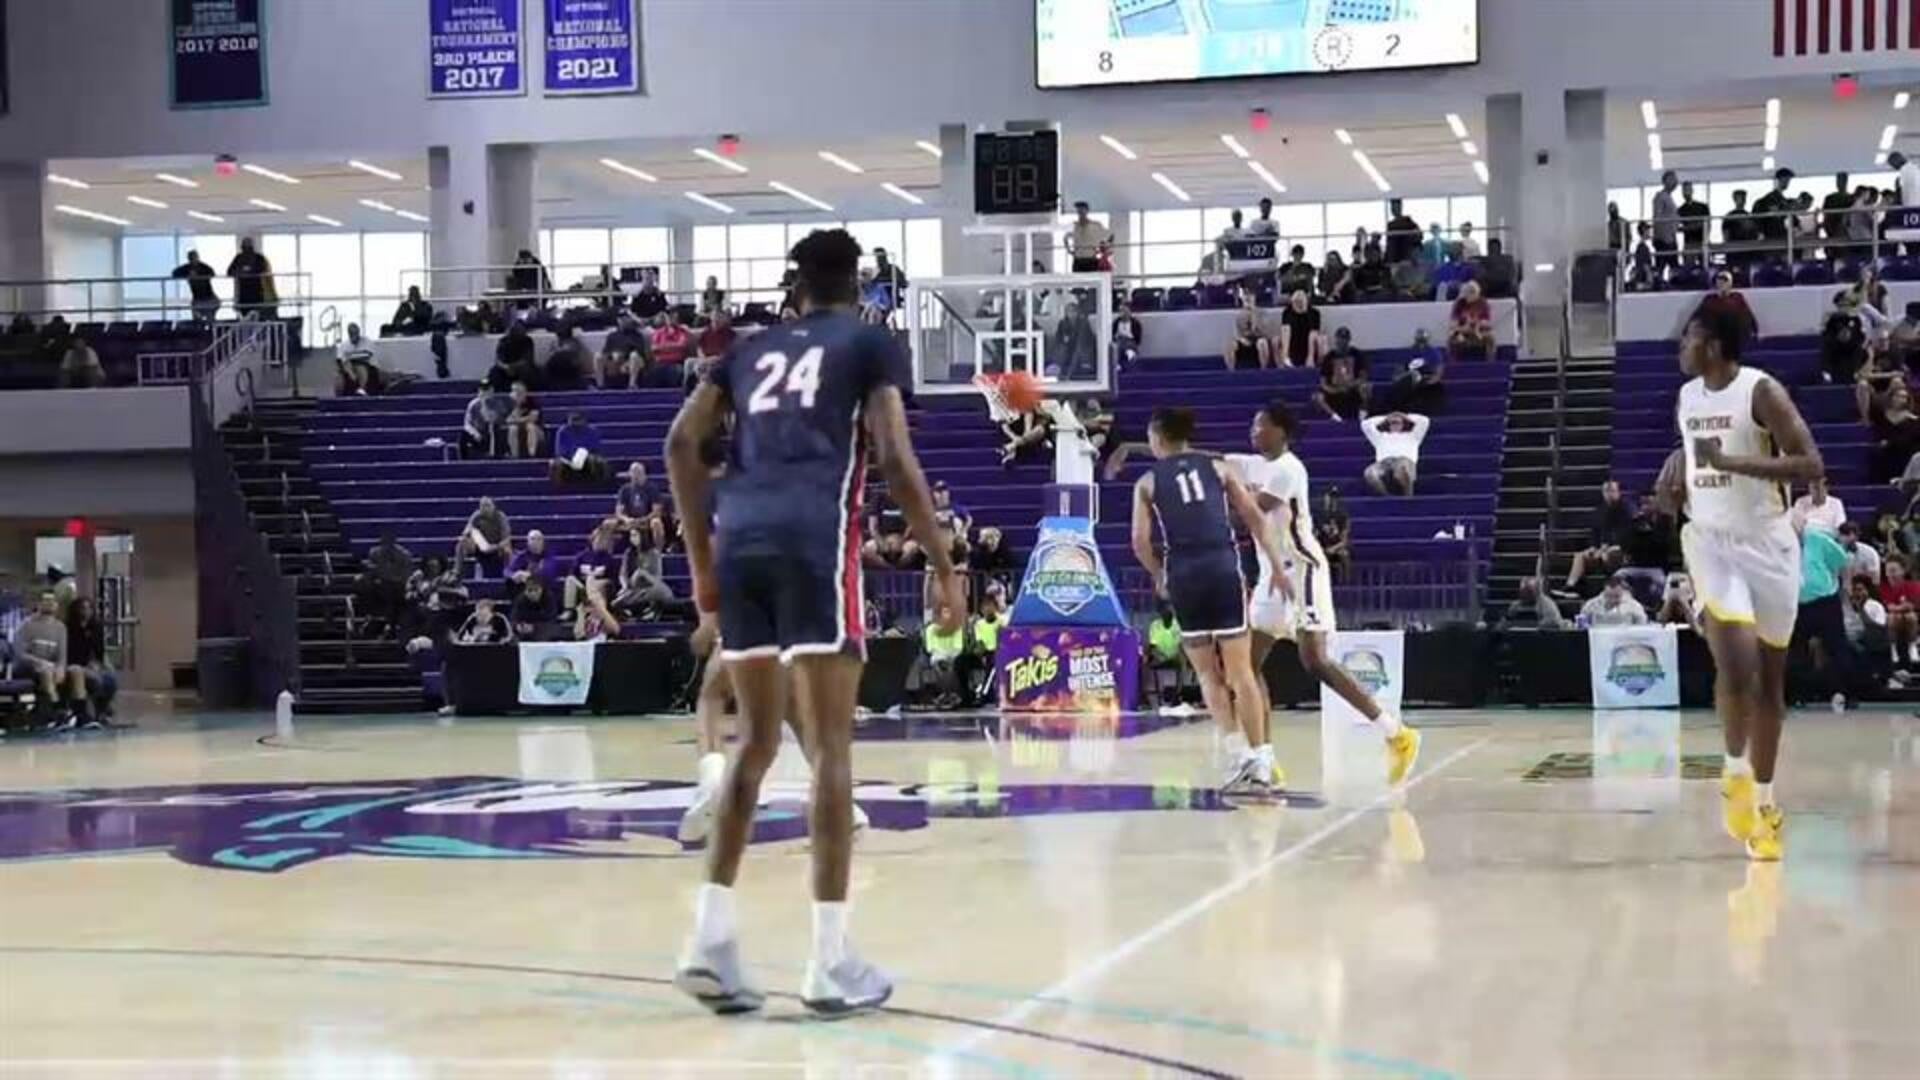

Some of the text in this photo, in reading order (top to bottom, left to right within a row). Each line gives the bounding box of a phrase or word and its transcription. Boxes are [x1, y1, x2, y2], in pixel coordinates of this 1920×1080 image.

[553, 18, 623, 34] NATIONAL
[176, 39, 214, 53] 2017
[548, 34, 628, 51] CHAMPIONS
[1384, 33, 1402, 57] 2
[434, 51, 516, 66] 3RD PLACE
[558, 57, 620, 80] 2021
[1097, 50, 1113, 72] 8
[445, 67, 505, 89] 2017
[748, 345, 825, 415] 24
[1175, 469, 1206, 503] 11
[1069, 654, 1110, 674] MOST
[1004, 655, 1059, 698] Takis
